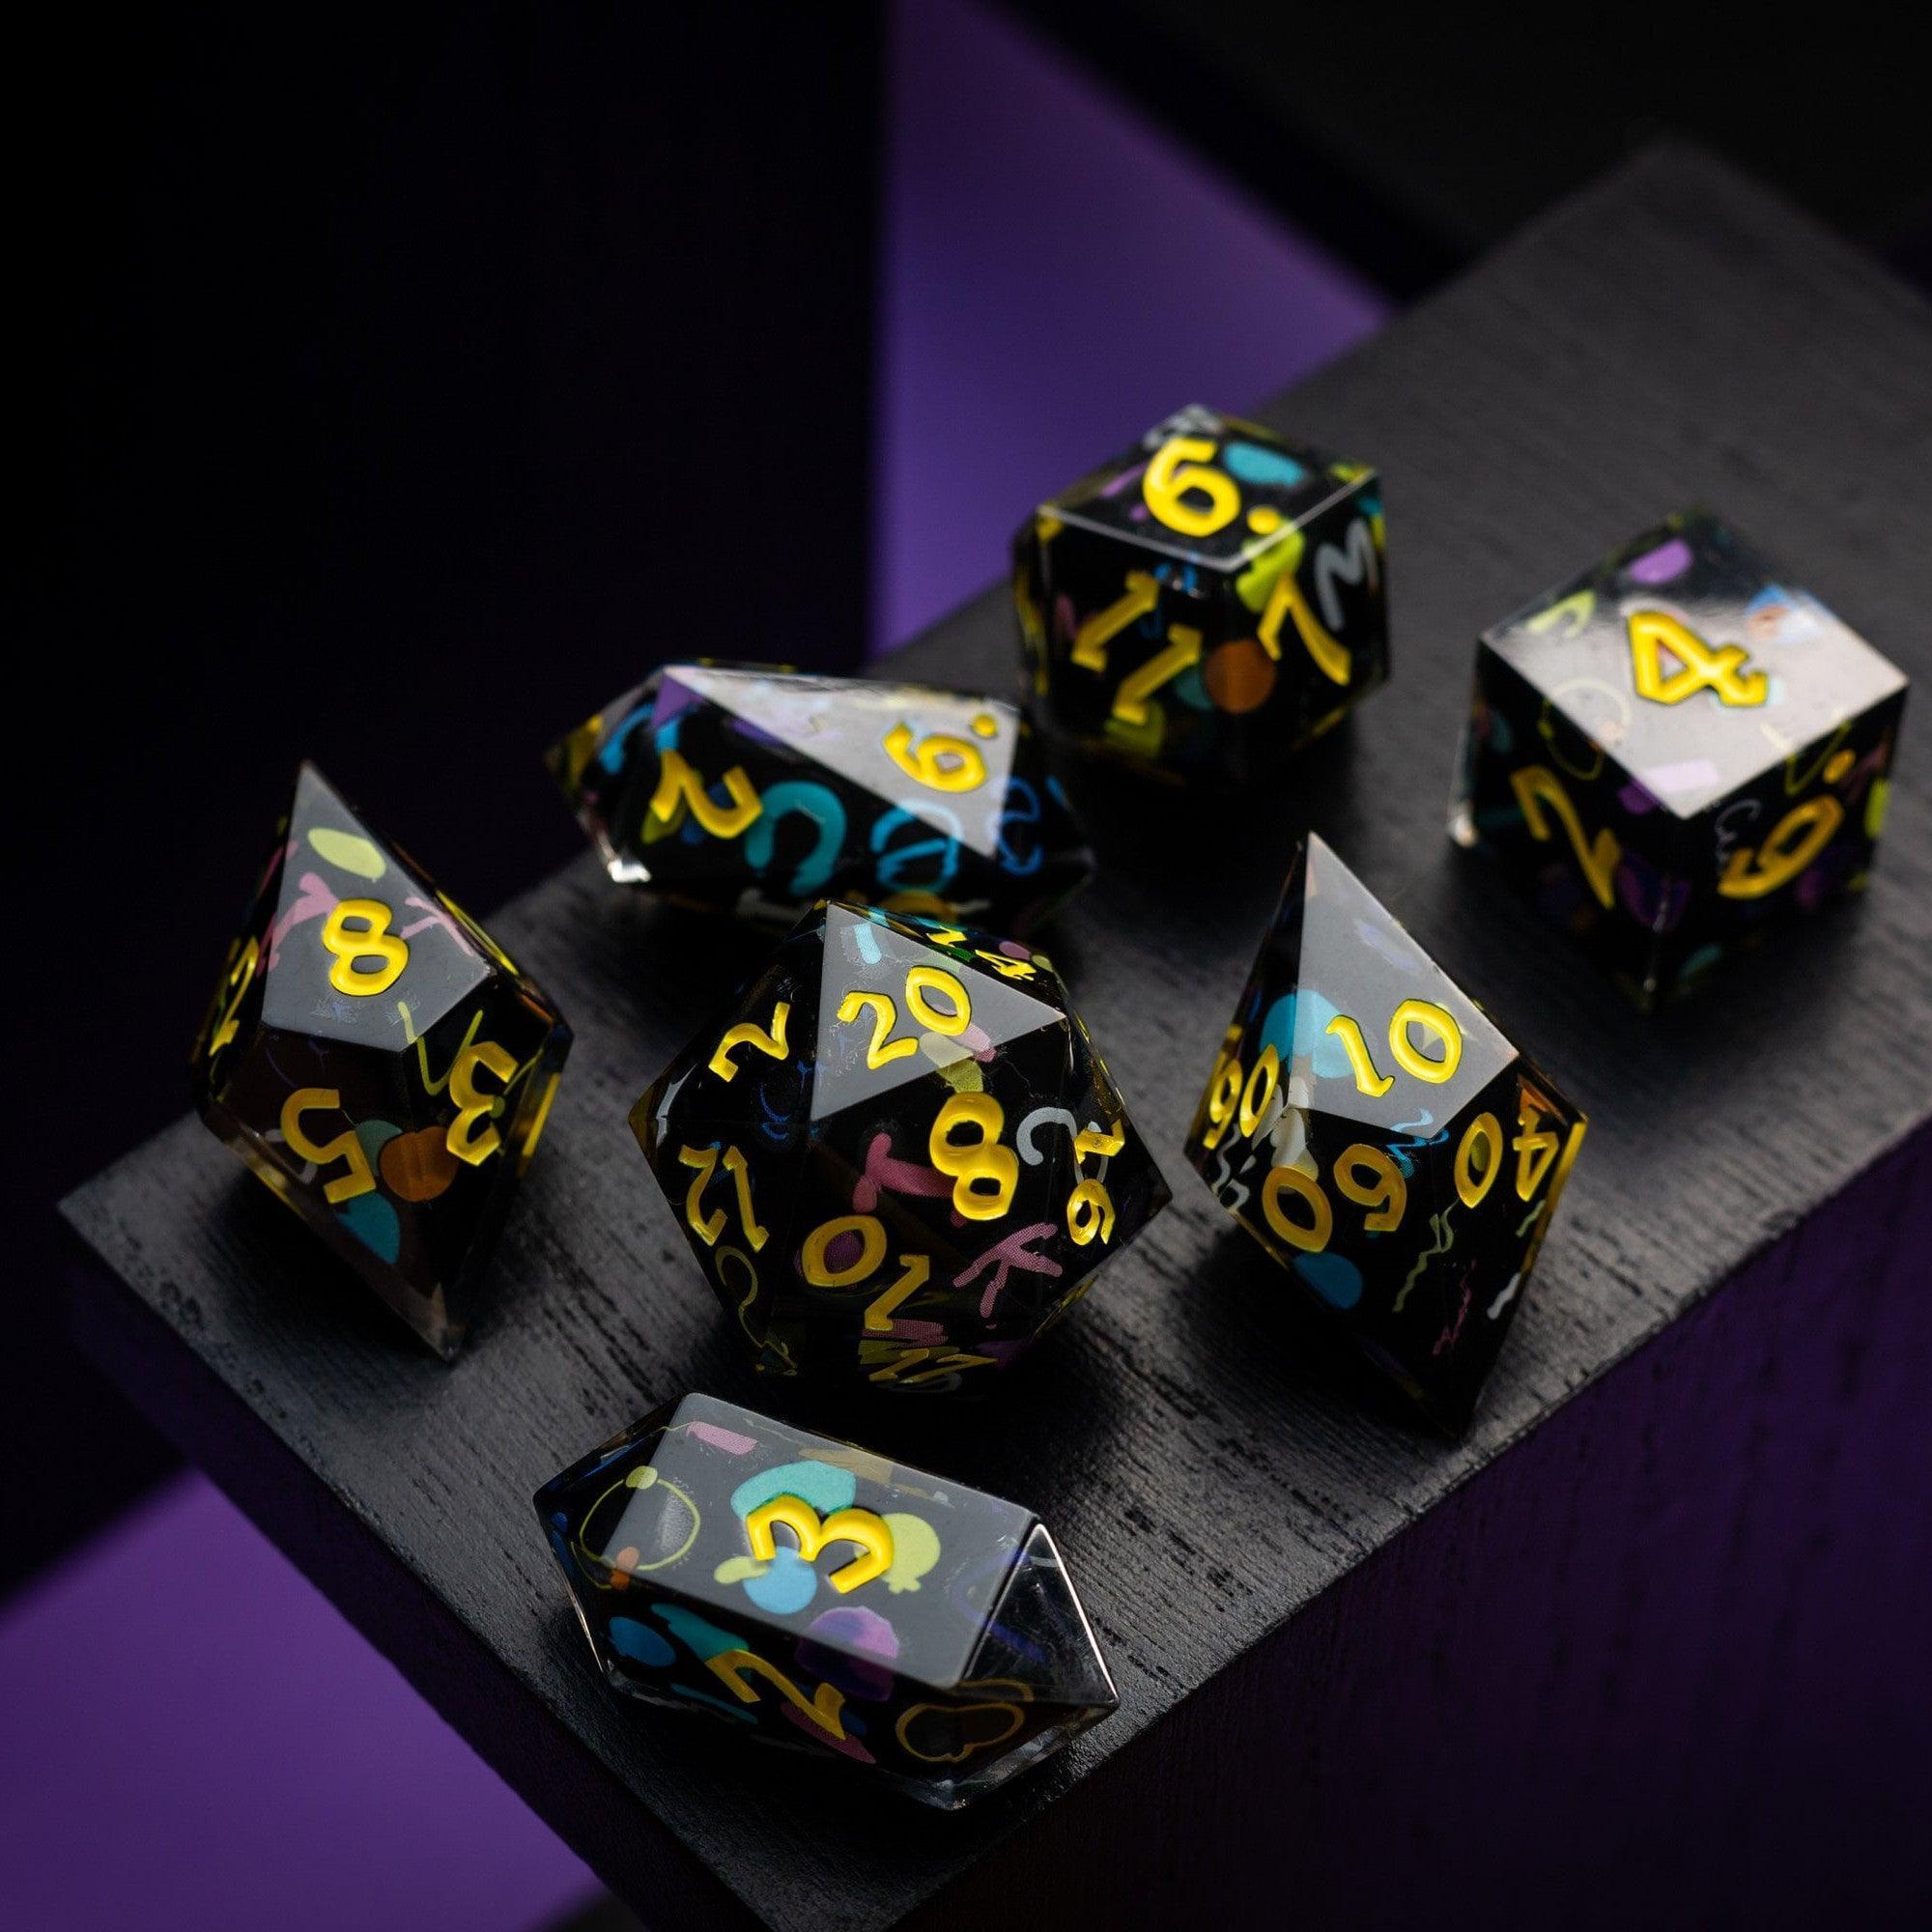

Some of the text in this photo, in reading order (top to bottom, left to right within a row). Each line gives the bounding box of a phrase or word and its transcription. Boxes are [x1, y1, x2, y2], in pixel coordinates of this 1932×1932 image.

[1071, 571, 1203, 725] 11
[1628, 611, 1770, 707] 4
[649, 749, 763, 838] 2
[1510, 764, 1623, 910] 2
[322, 898, 410, 998] 8
[925, 924, 1037, 981] 14
[708, 1002, 789, 1083] 2
[837, 965, 973, 1070] 20
[1324, 998, 1463, 1098] 10
[280, 1089, 377, 1205] 5
[446, 1040, 519, 1167] 3
[929, 1092, 1020, 1221] 8
[1065, 1119, 1126, 1246] 16
[1454, 1112, 1560, 1209] 40
[746, 1493, 895, 1594] 3
[703, 1648, 846, 1741] 2
